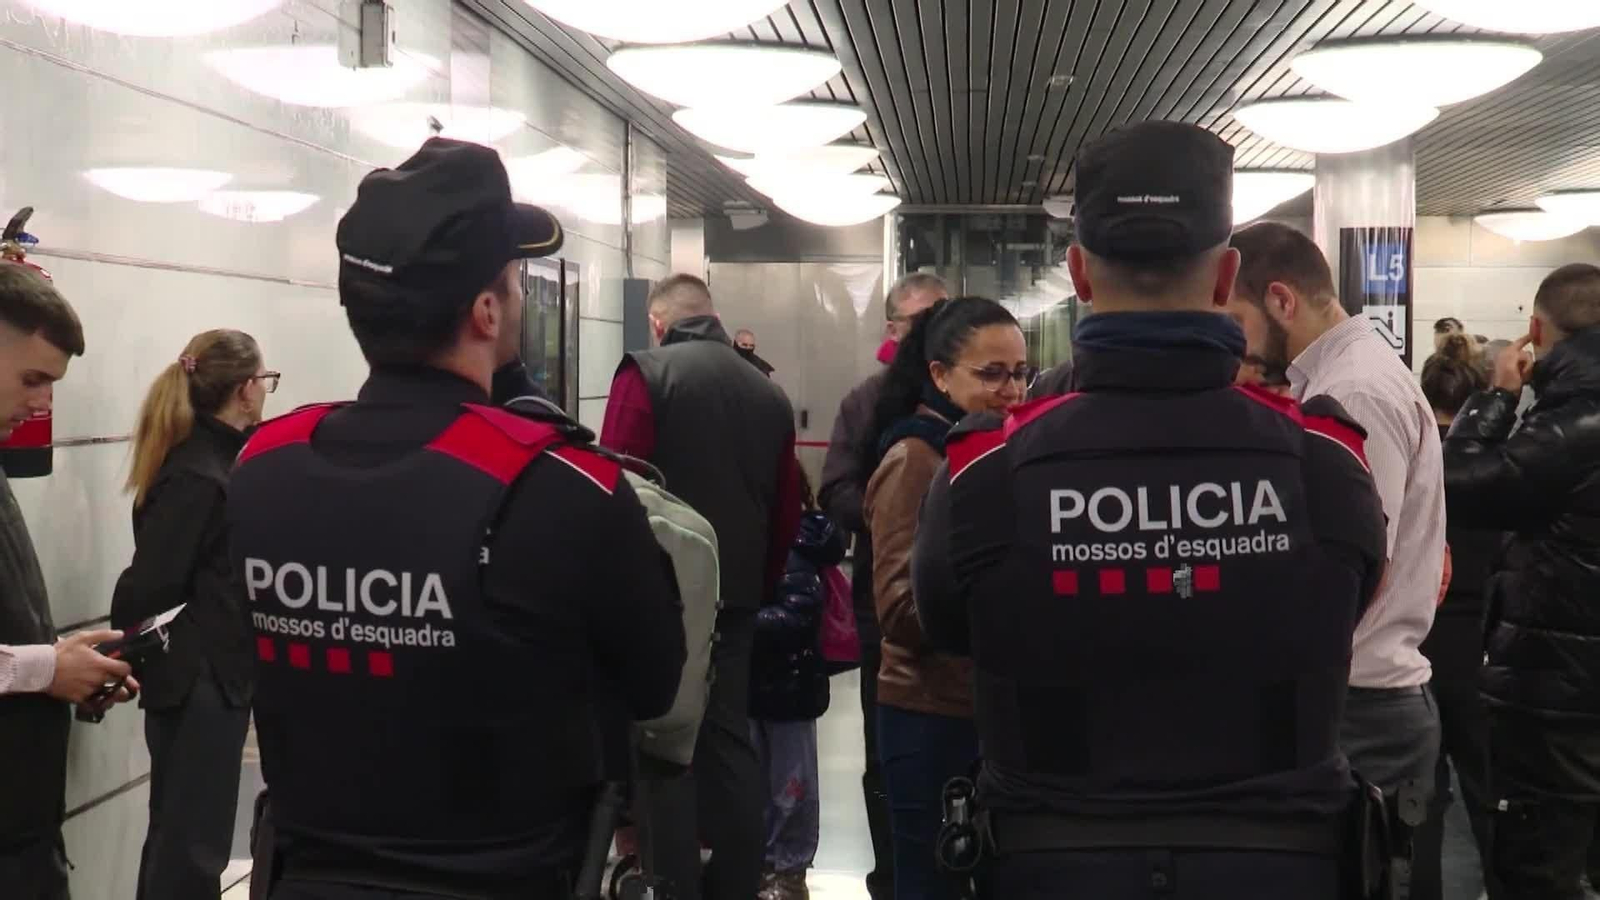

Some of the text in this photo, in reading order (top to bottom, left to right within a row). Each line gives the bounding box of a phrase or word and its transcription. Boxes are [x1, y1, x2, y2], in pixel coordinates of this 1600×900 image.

[1369, 253, 1404, 281] L5
[1050, 479, 1287, 533] POLICIA
[1052, 529, 1290, 561] mossos d'esquadra
[245, 557, 453, 619] POLICIA
[252, 611, 456, 649] mossos d'esquadra
